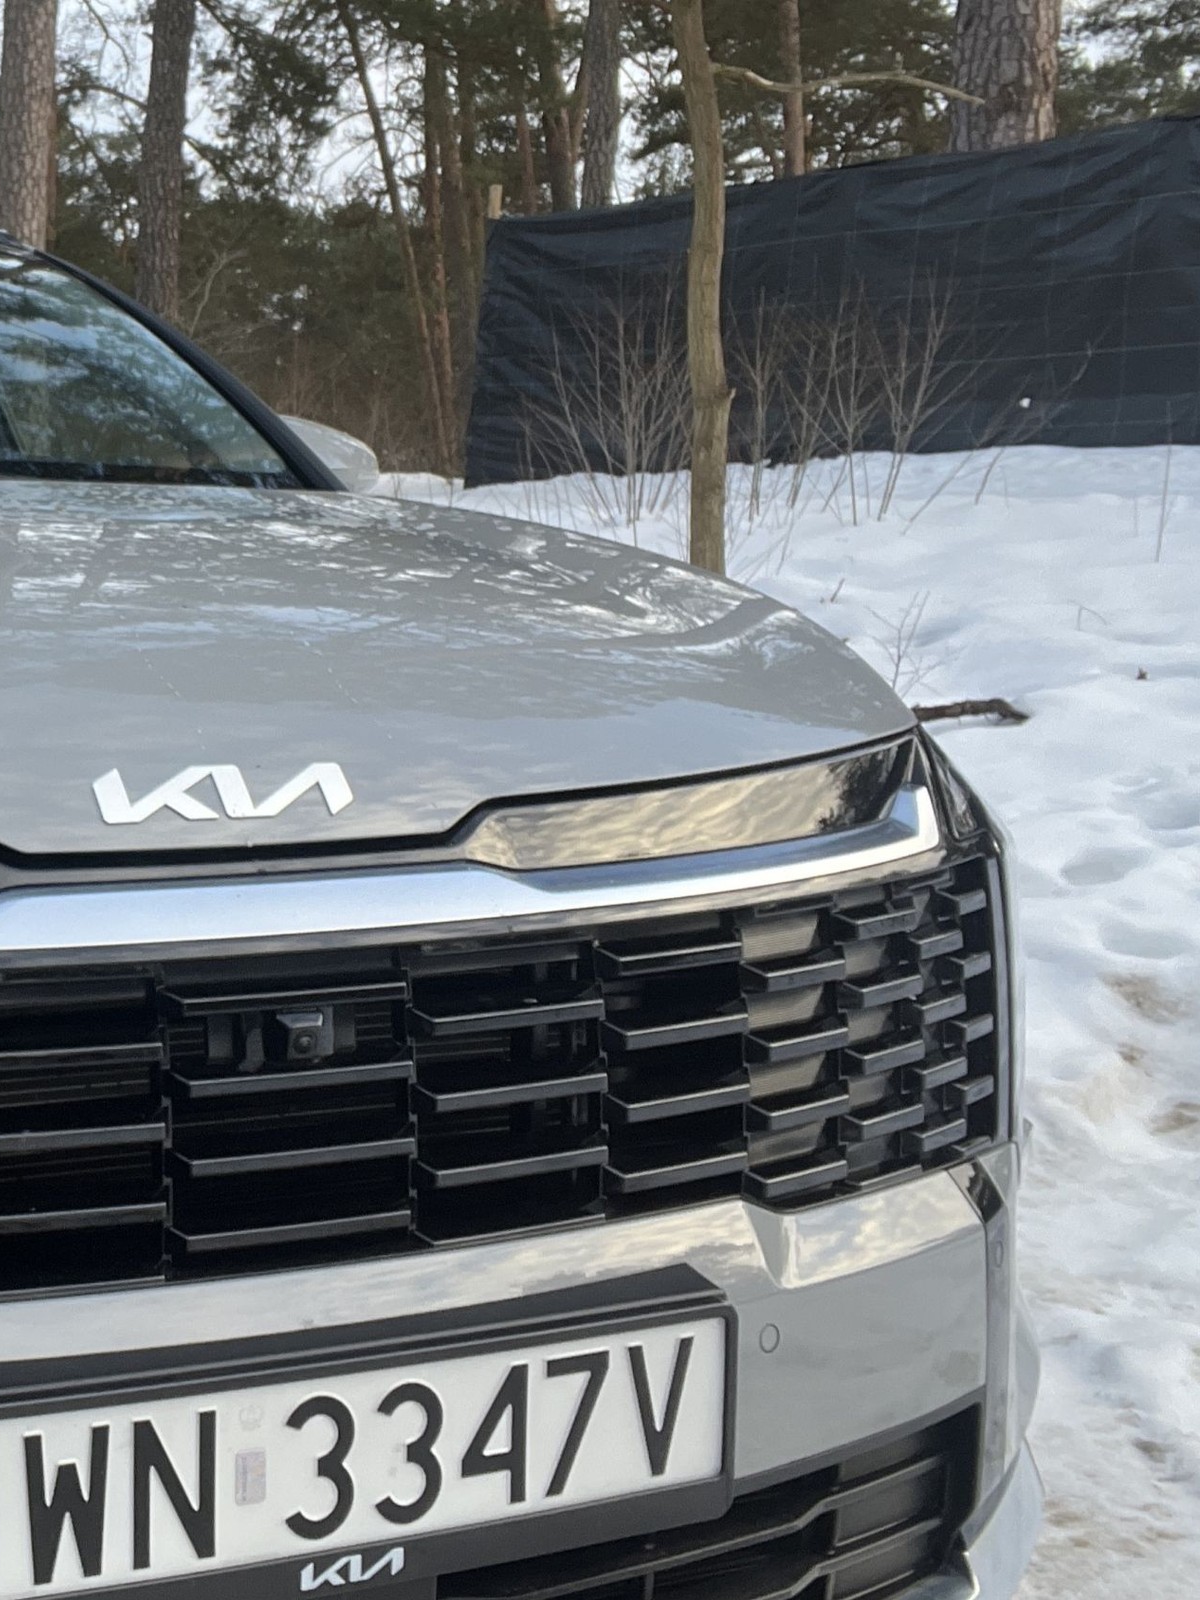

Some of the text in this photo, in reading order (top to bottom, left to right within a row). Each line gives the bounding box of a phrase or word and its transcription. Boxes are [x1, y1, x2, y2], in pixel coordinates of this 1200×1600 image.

[92, 762, 353, 824] KIA
[23, 1336, 695, 1585] WN 3347V
[300, 1547, 405, 1591] KIA
